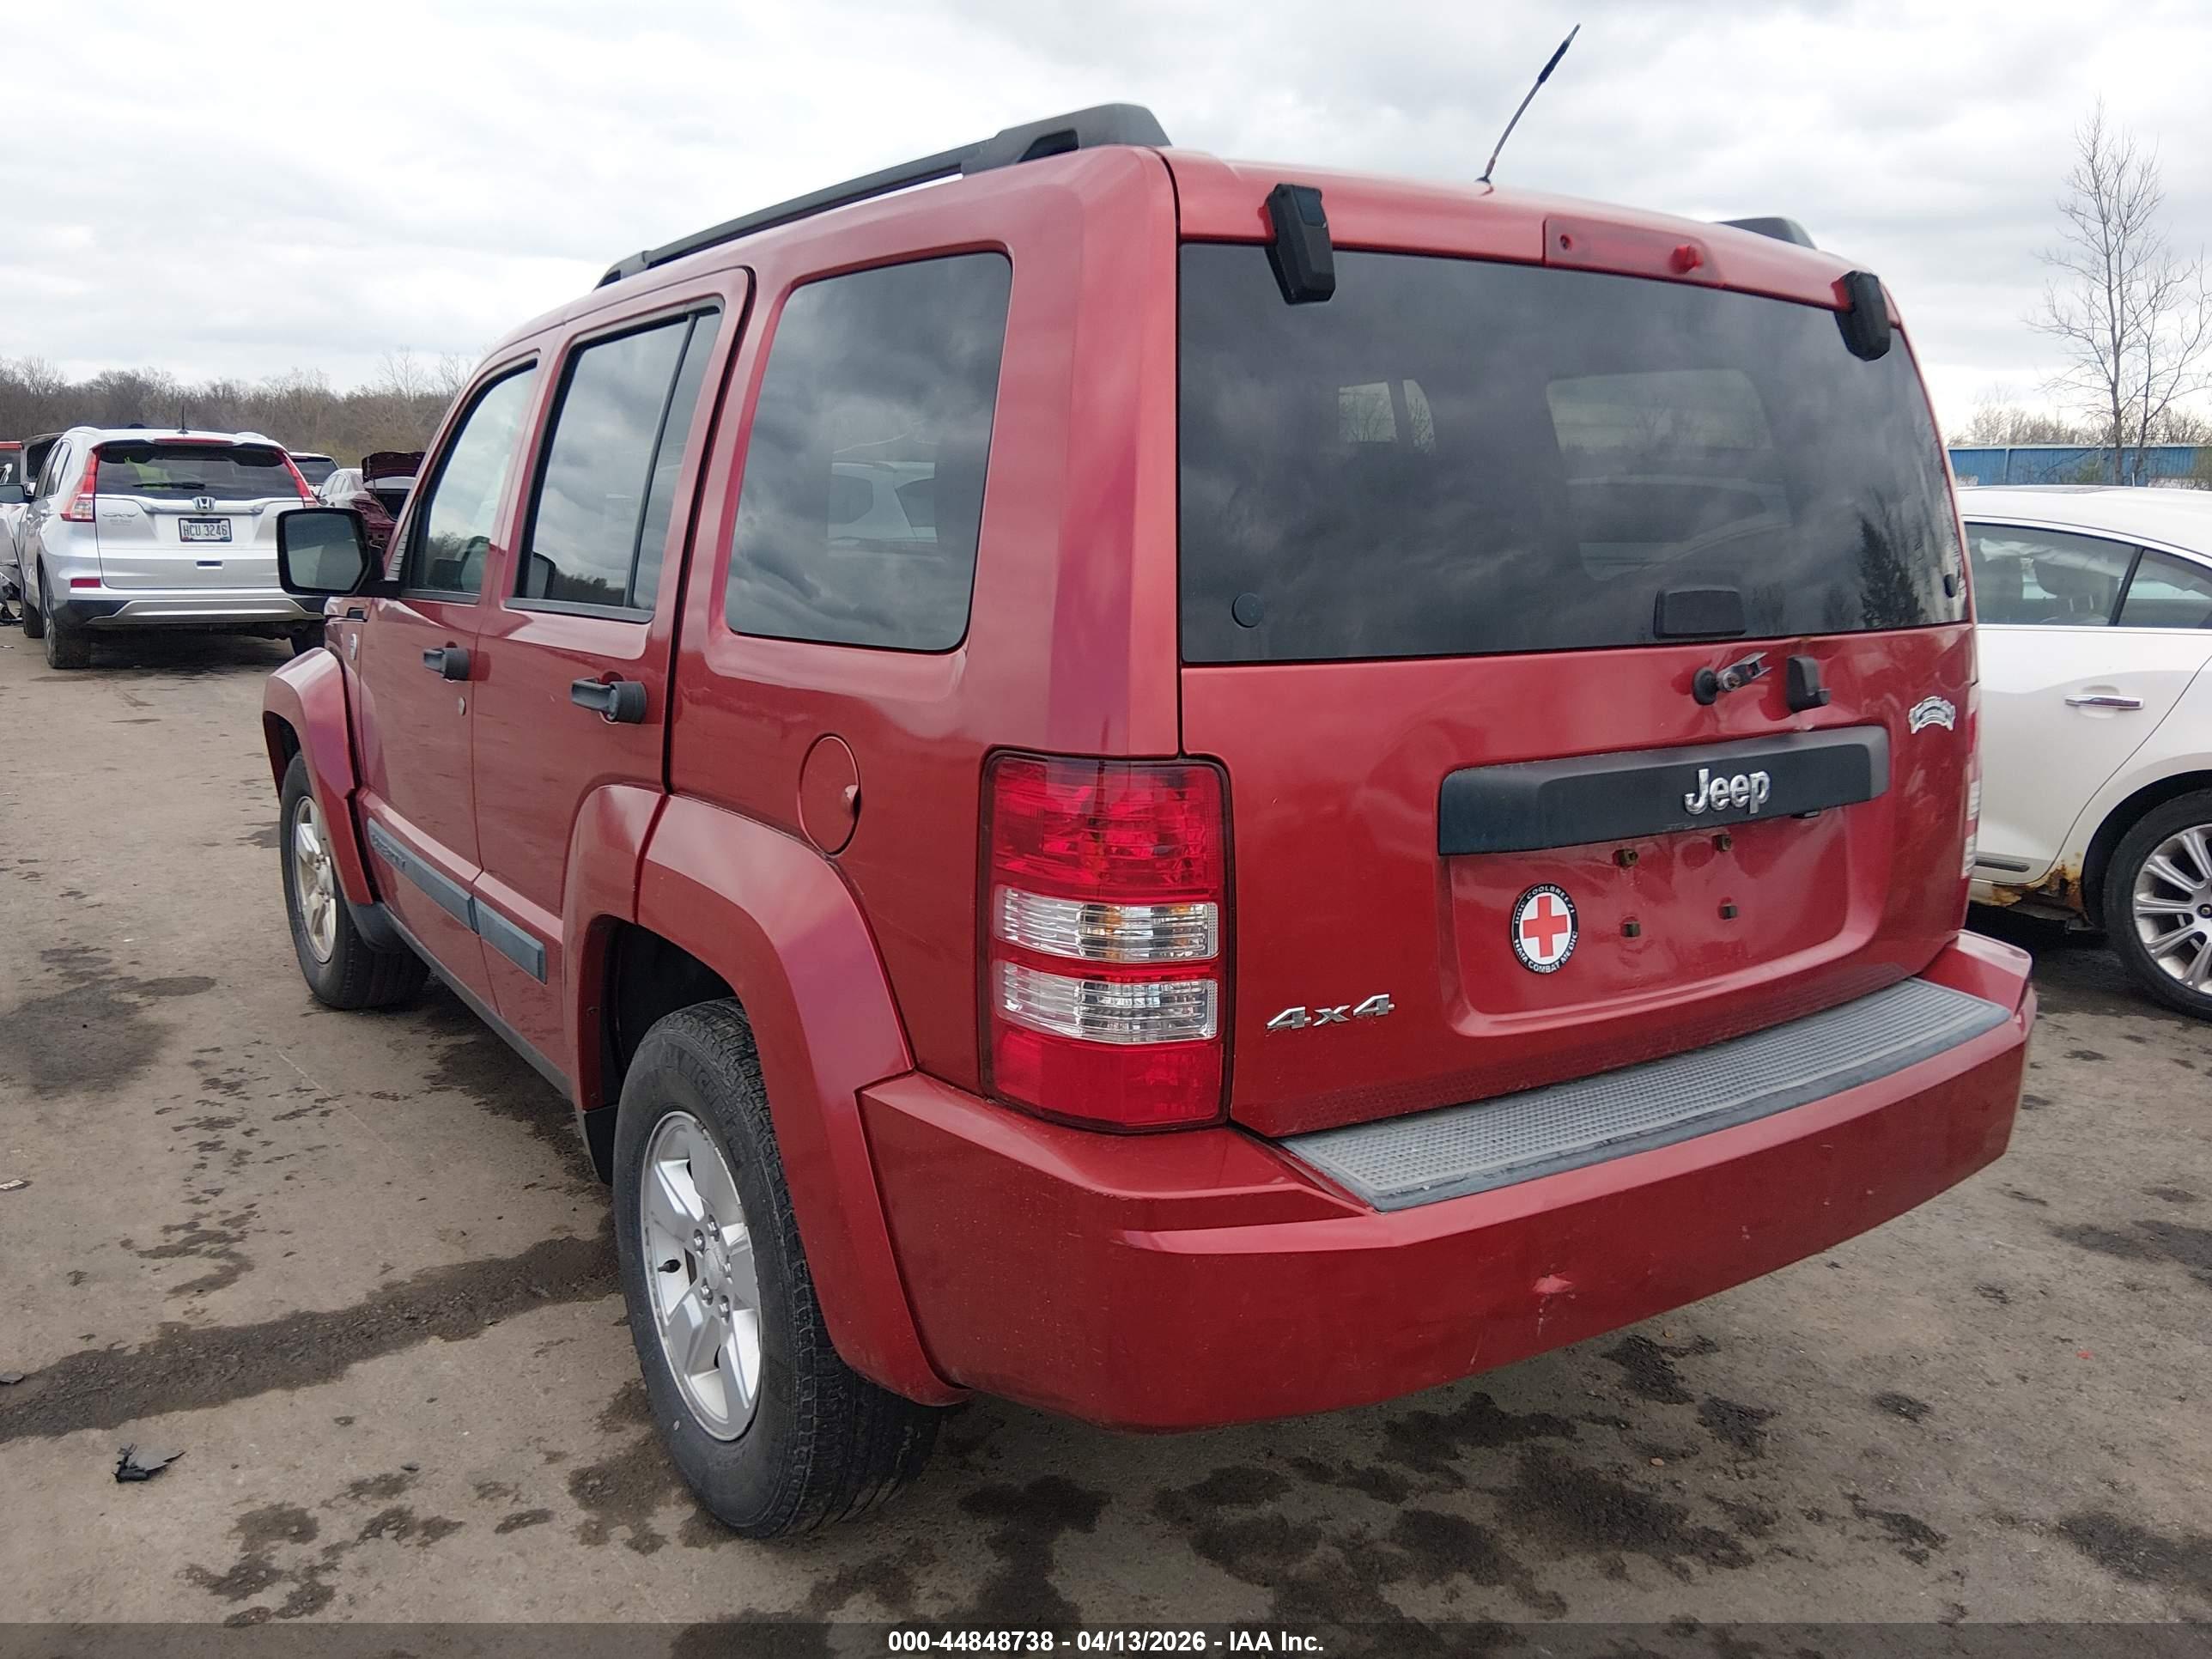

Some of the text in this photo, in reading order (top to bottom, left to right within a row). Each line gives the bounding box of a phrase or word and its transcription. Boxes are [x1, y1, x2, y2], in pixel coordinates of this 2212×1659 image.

[183, 525, 228, 537] HCU 3246
[1685, 768, 1770, 815] Jeep
[1528, 961, 1560, 974] COMBAT
[1560, 931, 1578, 963] MEDIC
[1267, 994, 1395, 1030] 4x4
